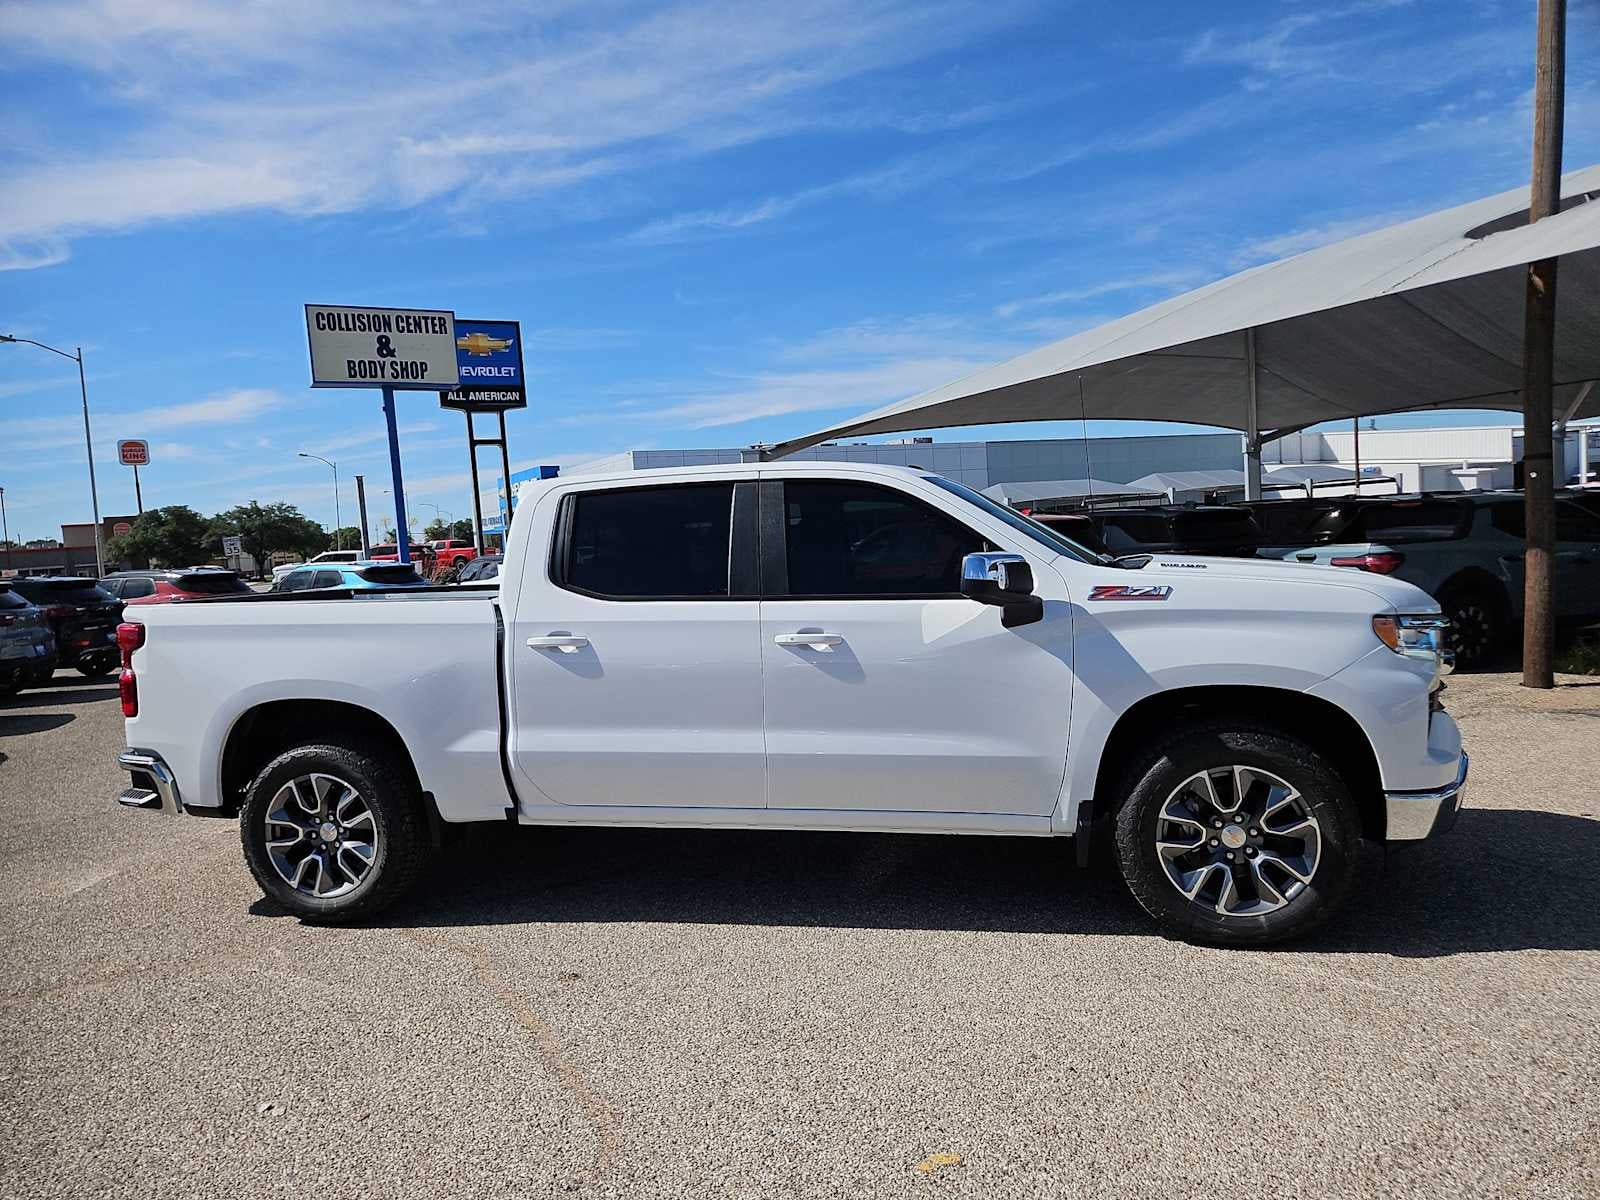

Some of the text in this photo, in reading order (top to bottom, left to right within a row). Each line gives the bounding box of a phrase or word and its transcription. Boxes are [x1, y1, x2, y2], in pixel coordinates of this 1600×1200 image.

[315, 311, 448, 335] COLLISION CENTER
[376, 335, 397, 358] &
[347, 359, 428, 380] BODY SHOP
[459, 366, 516, 377] EVROLET
[447, 391, 520, 401] ALL AMERICAN
[122, 452, 146, 460] KING
[226, 546, 240, 554] 35
[1090, 585, 1171, 599] Z71
